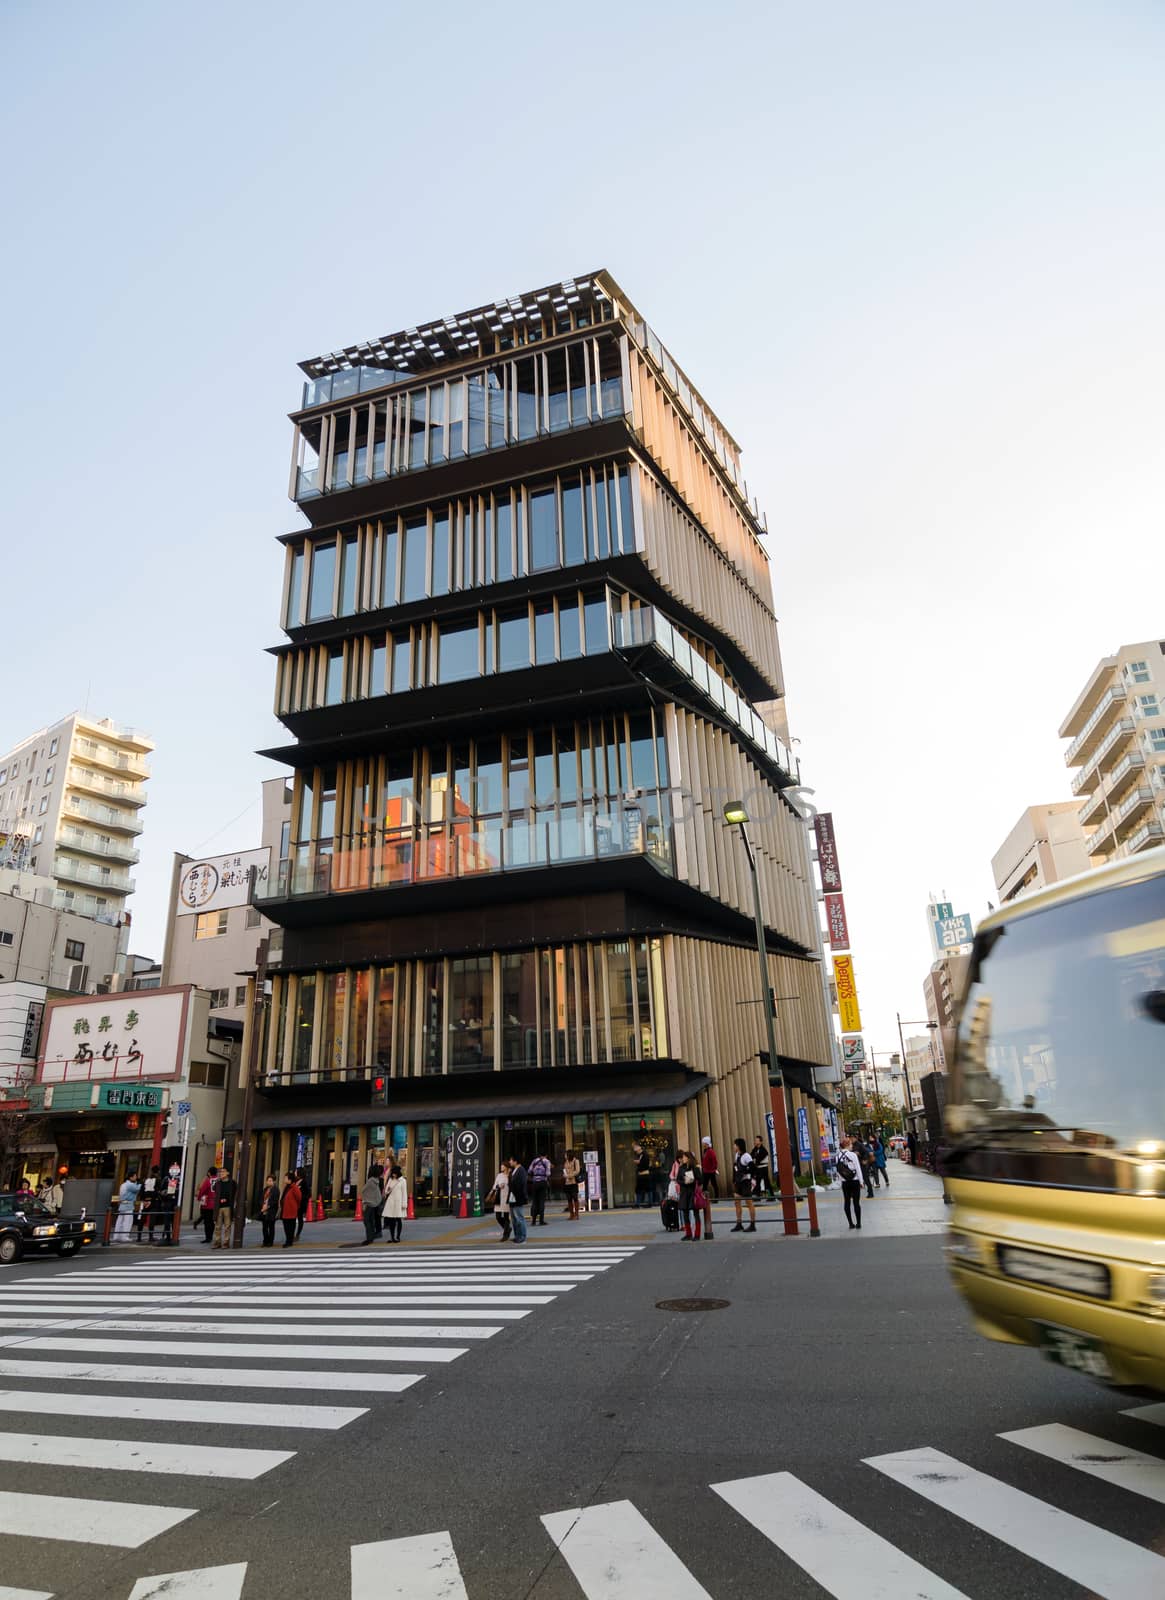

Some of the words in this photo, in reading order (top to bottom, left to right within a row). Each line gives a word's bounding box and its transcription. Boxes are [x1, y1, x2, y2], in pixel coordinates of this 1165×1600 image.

[188, 870, 199, 904] 西むら
[940, 916, 965, 931] YKK
[943, 927, 967, 946] ap
[834, 957, 856, 999] Denny's
[74, 1038, 141, 1065] 西むら
